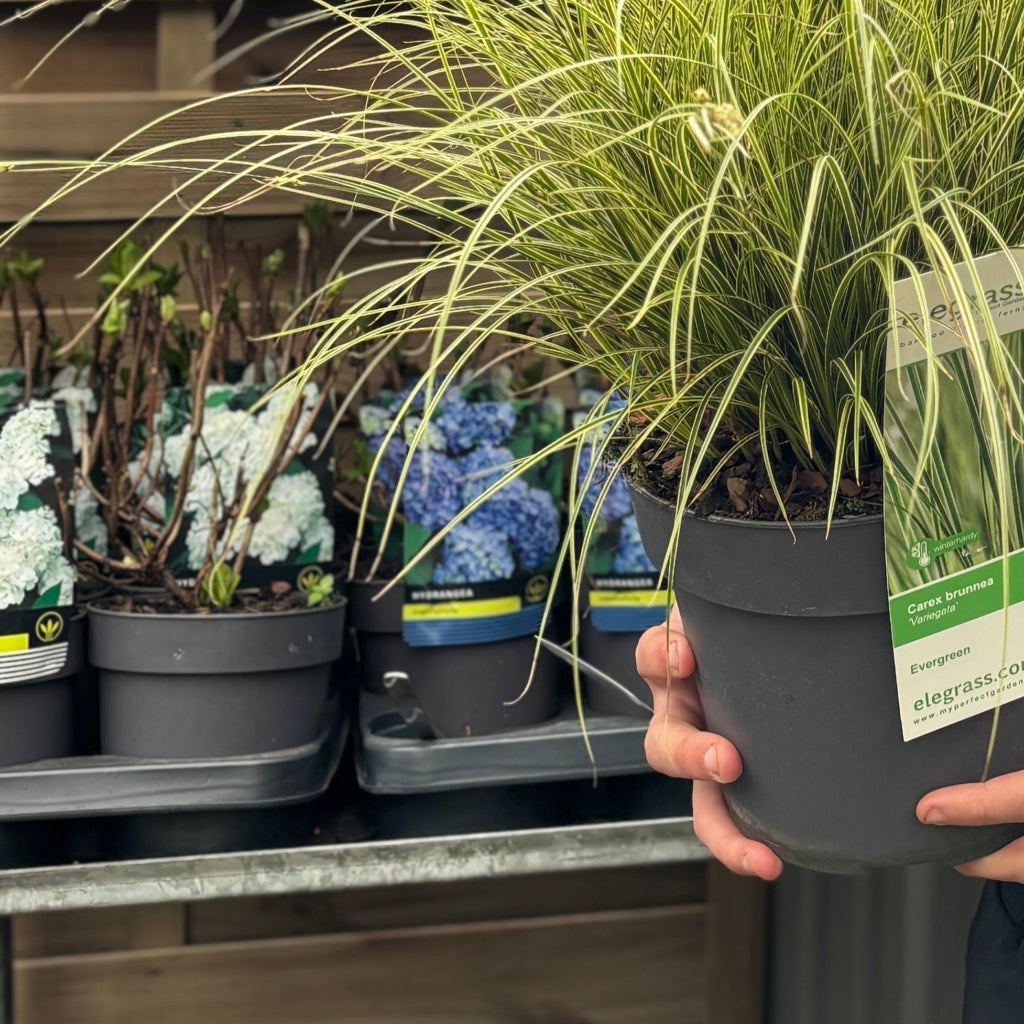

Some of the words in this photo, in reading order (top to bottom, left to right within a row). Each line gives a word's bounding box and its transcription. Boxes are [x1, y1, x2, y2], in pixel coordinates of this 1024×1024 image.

[932, 531, 978, 553] winterhardy
[907, 595, 942, 615] Carex
[945, 577, 994, 601] brunnea
[910, 646, 971, 675] Evergreen
